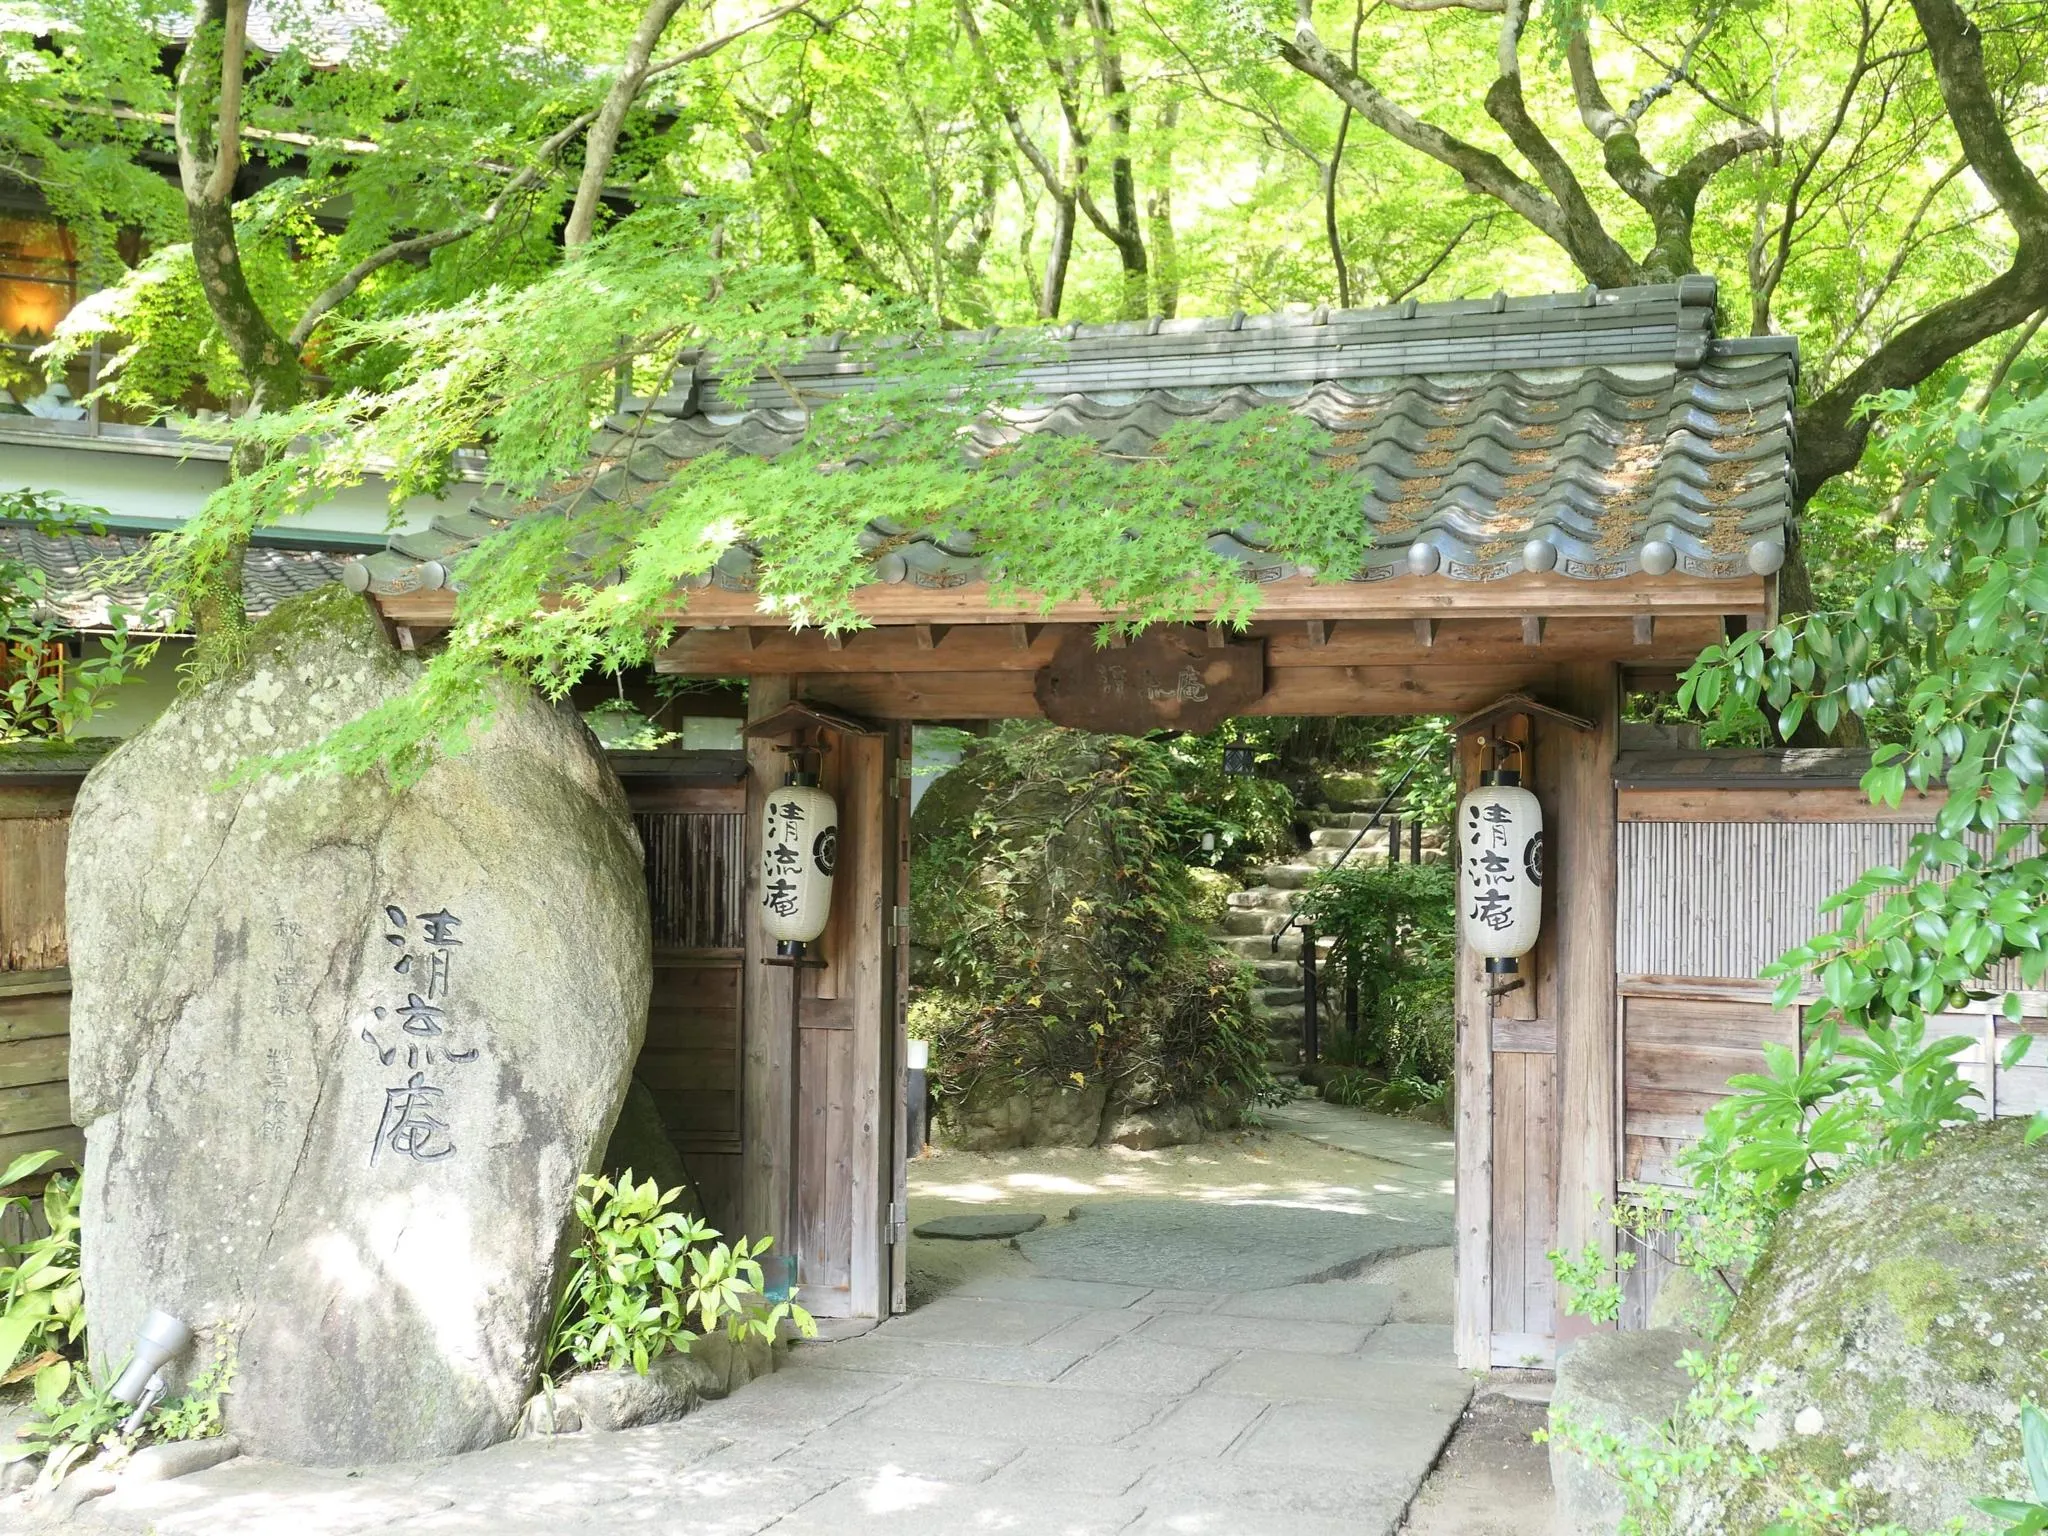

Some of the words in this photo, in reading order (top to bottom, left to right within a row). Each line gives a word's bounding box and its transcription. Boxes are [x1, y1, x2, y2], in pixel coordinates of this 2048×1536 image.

[762, 801, 805, 918] 清流庵
[1468, 803, 1515, 932] 清流庵
[361, 904, 480, 1168] 清流庵
